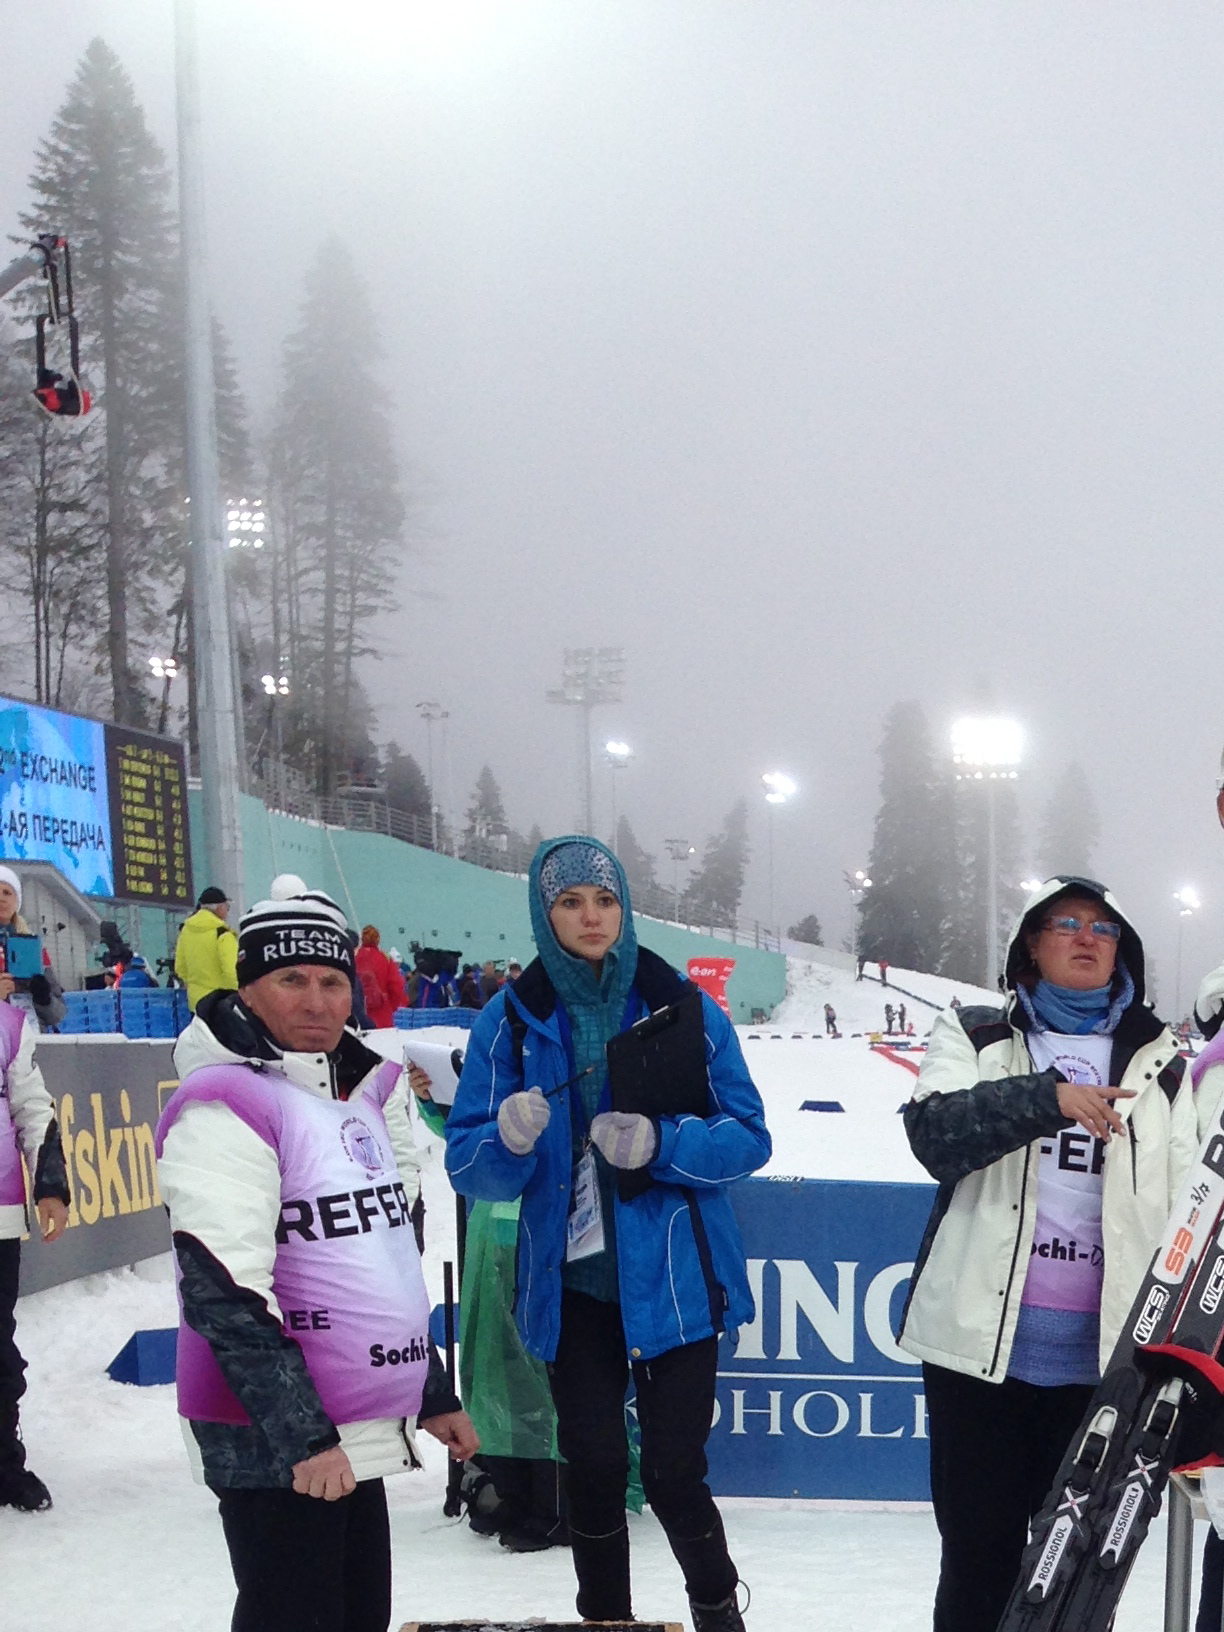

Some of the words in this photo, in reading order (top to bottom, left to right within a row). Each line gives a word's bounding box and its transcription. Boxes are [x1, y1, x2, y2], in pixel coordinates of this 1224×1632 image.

[21, 750, 98, 793] EXCHANGE
[33, 813, 107, 853] ПЕРЕДАЧА
[263, 940, 351, 966] RUSSIA
[275, 929, 342, 944] TEAM
[1136, 1289, 1164, 1339] WCS
[1037, 1526, 1068, 1581] ROSSIGNOL
